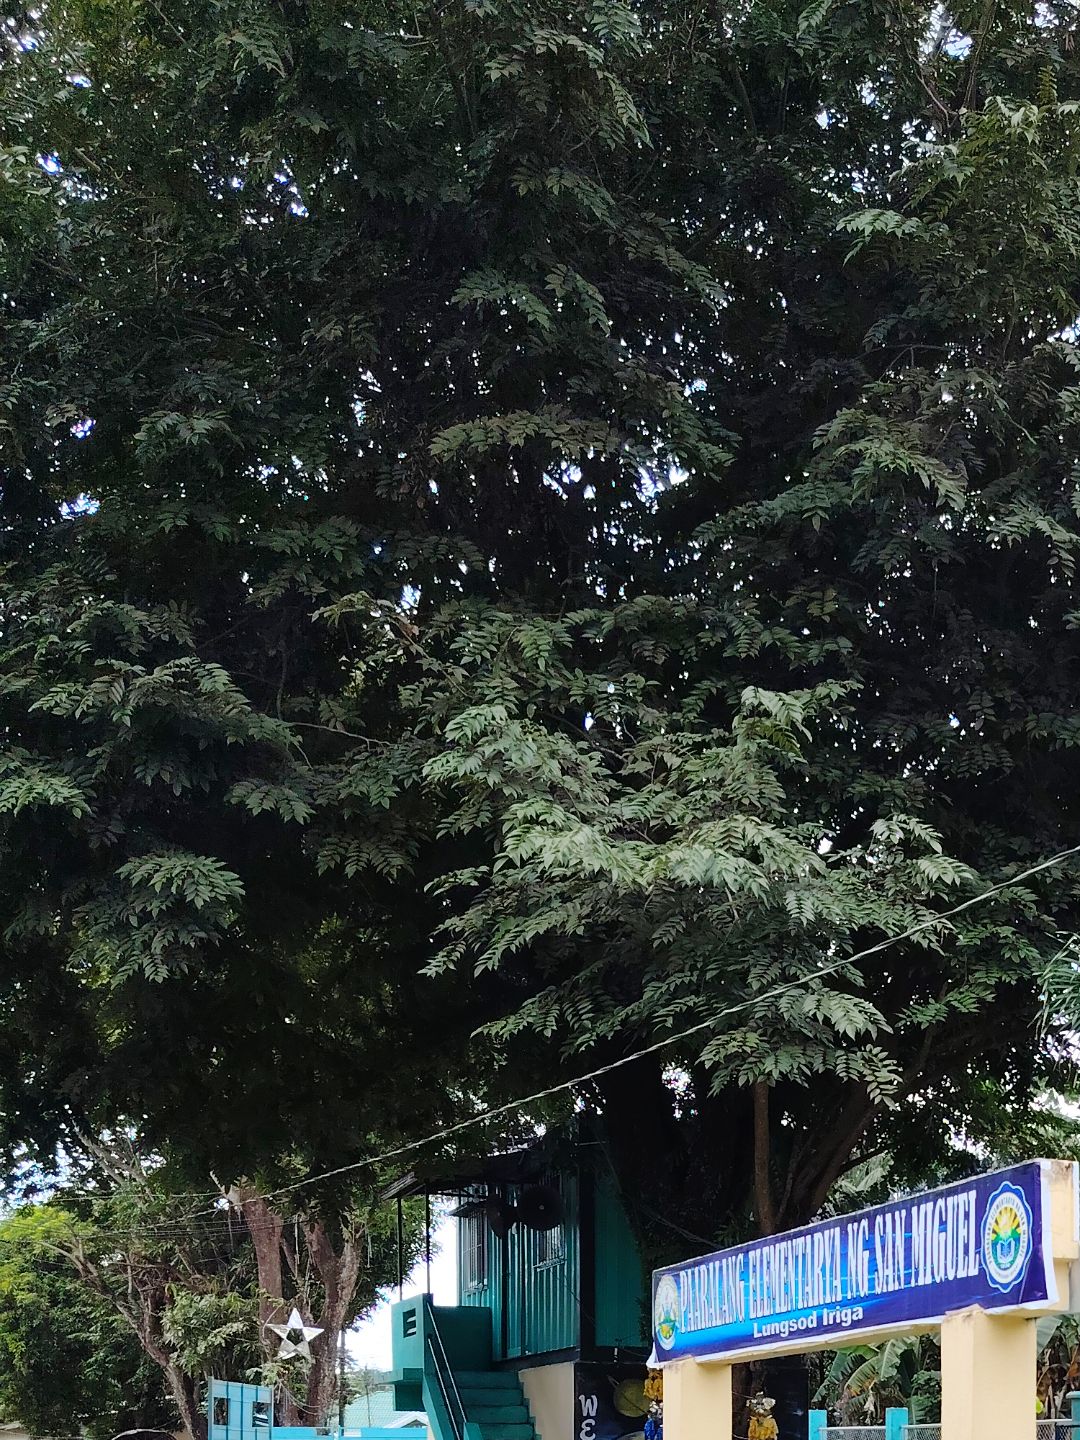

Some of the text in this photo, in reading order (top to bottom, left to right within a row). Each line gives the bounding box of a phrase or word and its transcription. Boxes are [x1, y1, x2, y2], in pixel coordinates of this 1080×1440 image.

[680, 1253, 745, 1334] PAARALANG
[749, 1227, 842, 1320] ELEMENTARYA
[847, 1218, 870, 1300] NG
[874, 1209, 906, 1295] SAN
[911, 1190, 979, 1287] MIGUEL
[753, 1306, 864, 1339] Lungsod Iriga
